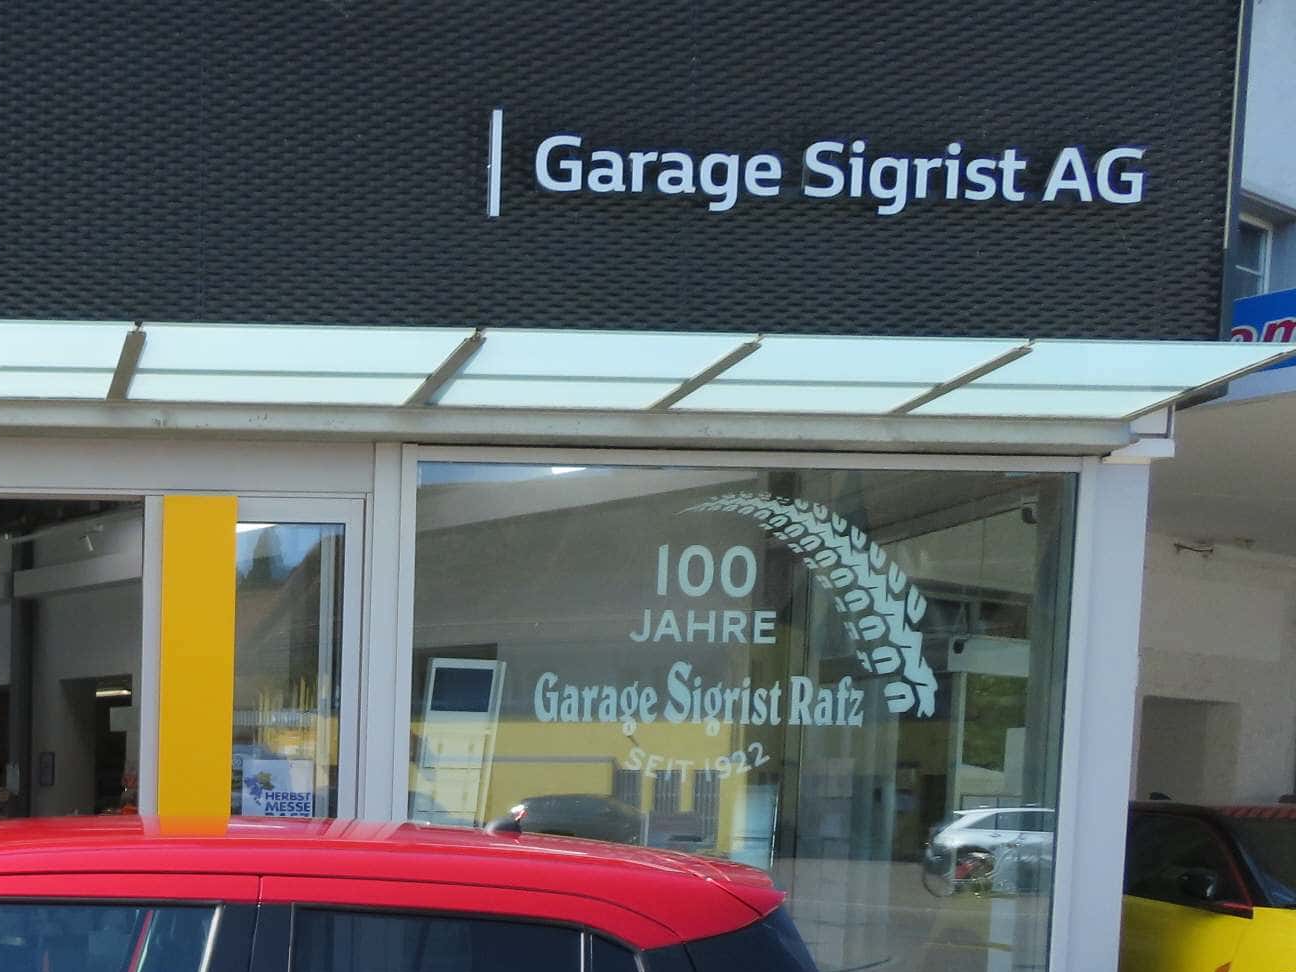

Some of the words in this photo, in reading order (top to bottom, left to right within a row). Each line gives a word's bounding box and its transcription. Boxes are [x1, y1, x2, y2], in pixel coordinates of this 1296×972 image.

[534, 135, 782, 212] Garage
[804, 140, 1026, 215] Sigrist
[1042, 146, 1146, 204] AG
[657, 544, 757, 597] 100
[629, 609, 776, 643] JAHRE
[534, 671, 658, 736] Garage
[664, 661, 782, 736] Sigrist
[788, 675, 864, 728] Rafz
[624, 747, 694, 783] SEIT
[704, 742, 770, 782] 1922
[265, 792, 311, 801] HERBST
[265, 801, 311, 812] MESSE
